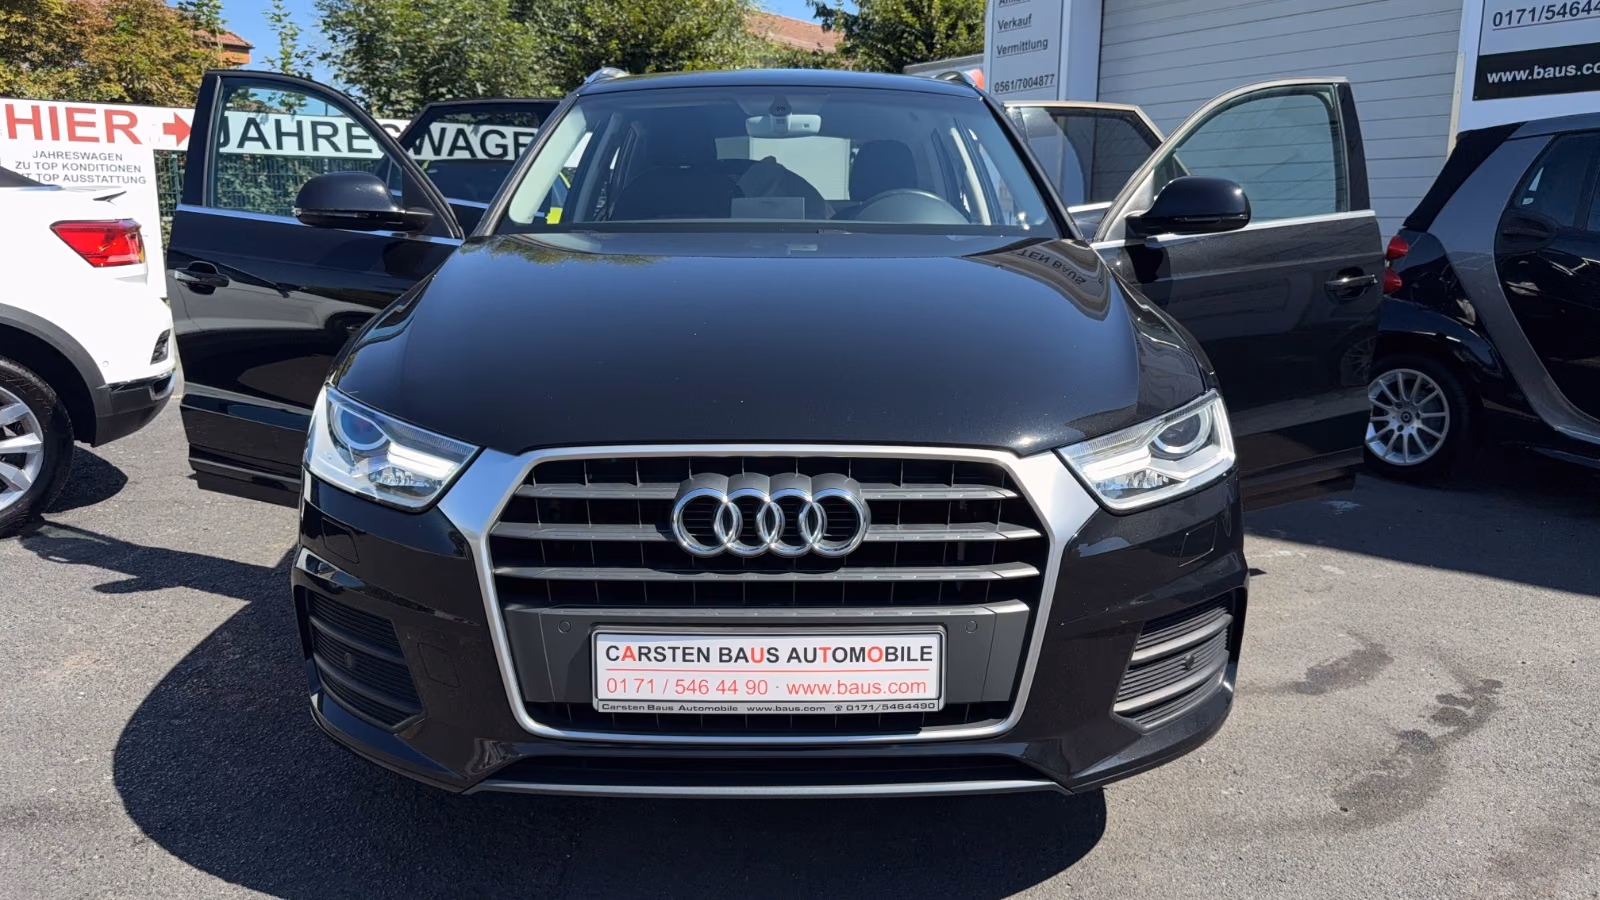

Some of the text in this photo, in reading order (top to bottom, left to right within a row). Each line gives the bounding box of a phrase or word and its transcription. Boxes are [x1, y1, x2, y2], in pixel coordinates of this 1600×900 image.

[998, 13, 1032, 31] Verkauf
[996, 39, 1049, 55] Vermittlung
[994, 74, 1055, 93] 0561/7004877
[5, 104, 142, 145] HIER
[32, 150, 123, 161] JAHRESWAGEN
[15, 161, 142, 173] ZU TOP KONDITIONEN
[36, 173, 60, 182] TOP
[63, 174, 146, 184] AUSSTATTUNG
[605, 645, 933, 664] CARSTEN BAUS AUTOMOBILE
[675, 679, 709, 695] 546
[715, 679, 739, 695] 44
[745, 679, 768, 695] 90
[786, 680, 927, 696] www.baus.com
[602, 703, 645, 711] Carsten
[846, 702, 935, 711] 0171/5464490
